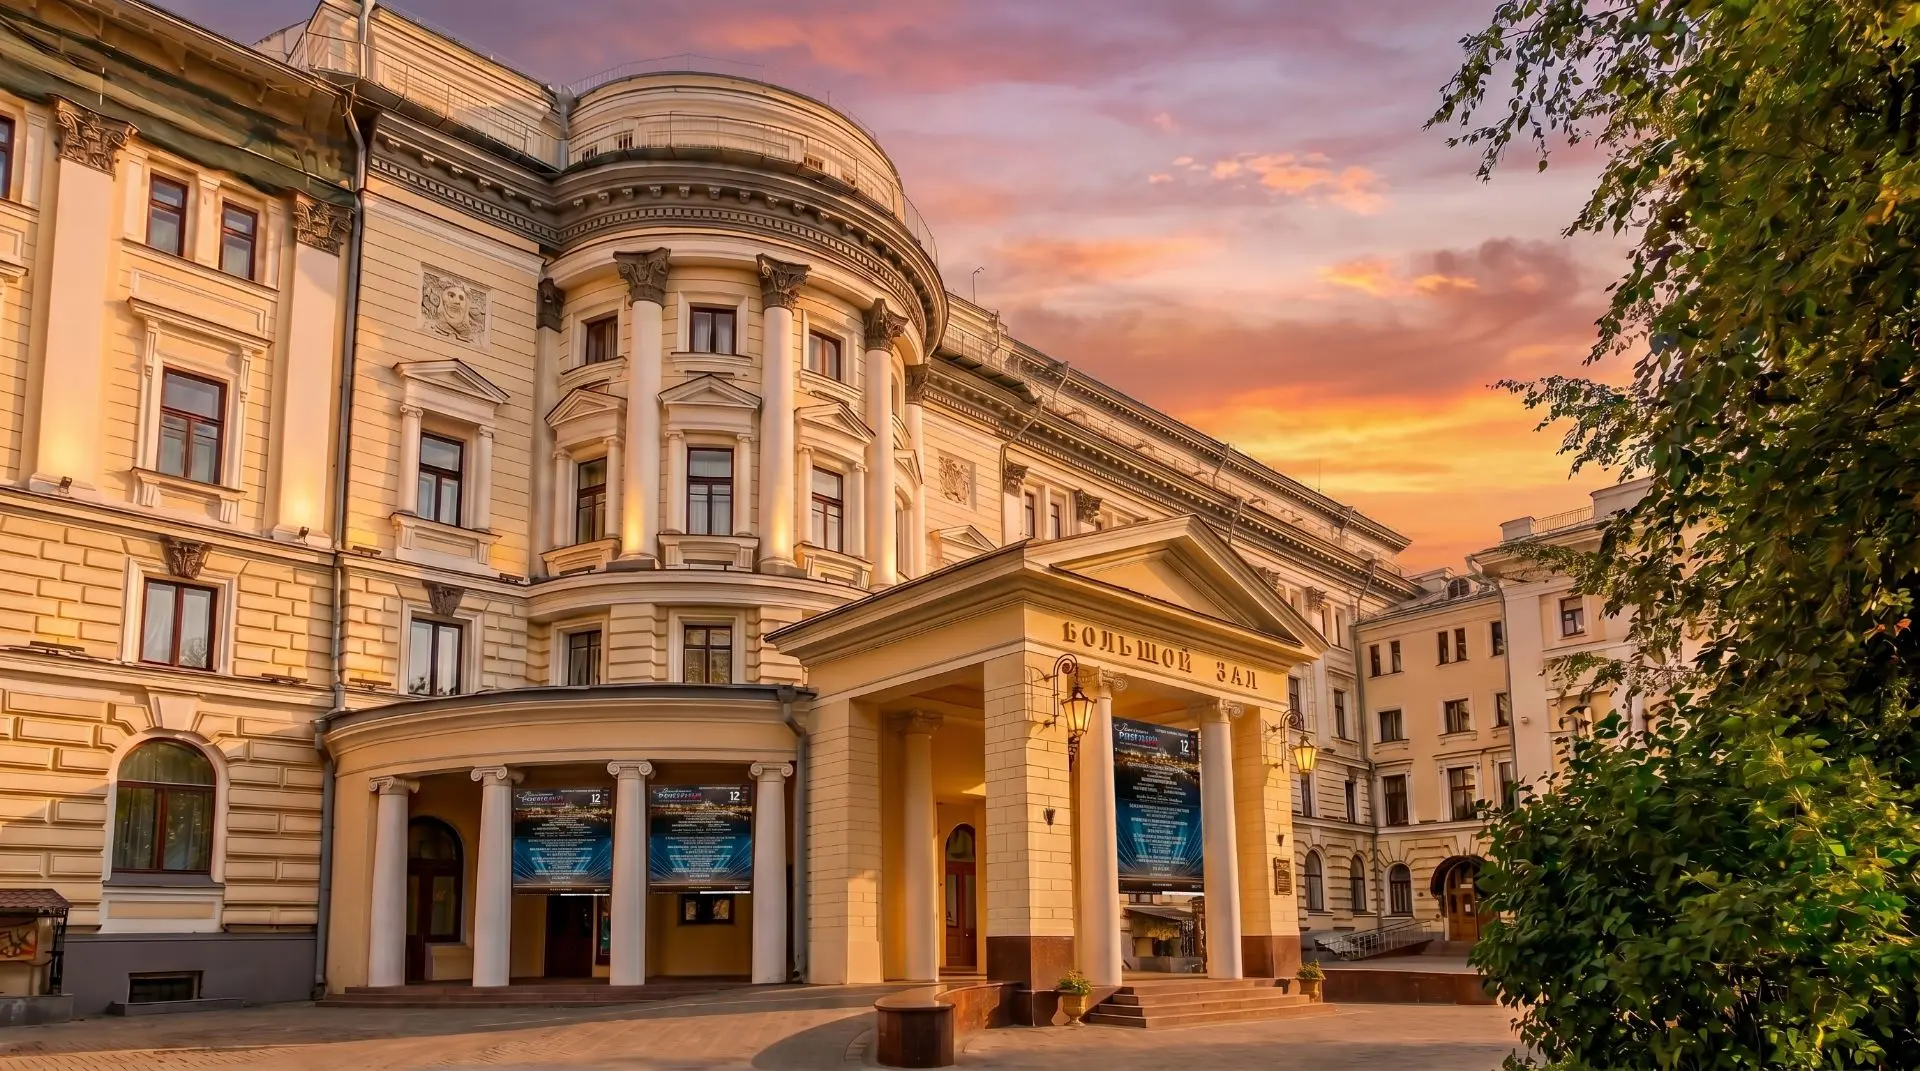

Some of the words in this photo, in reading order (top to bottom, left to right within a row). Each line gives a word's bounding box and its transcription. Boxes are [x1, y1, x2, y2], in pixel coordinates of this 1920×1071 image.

[1062, 621, 1192, 673] БОЛЬШОЙ
[1216, 661, 1258, 690] ЗАЛ
[1180, 739, 1189, 753] 12
[591, 793, 601, 803] 12
[729, 791, 740, 801] 12
